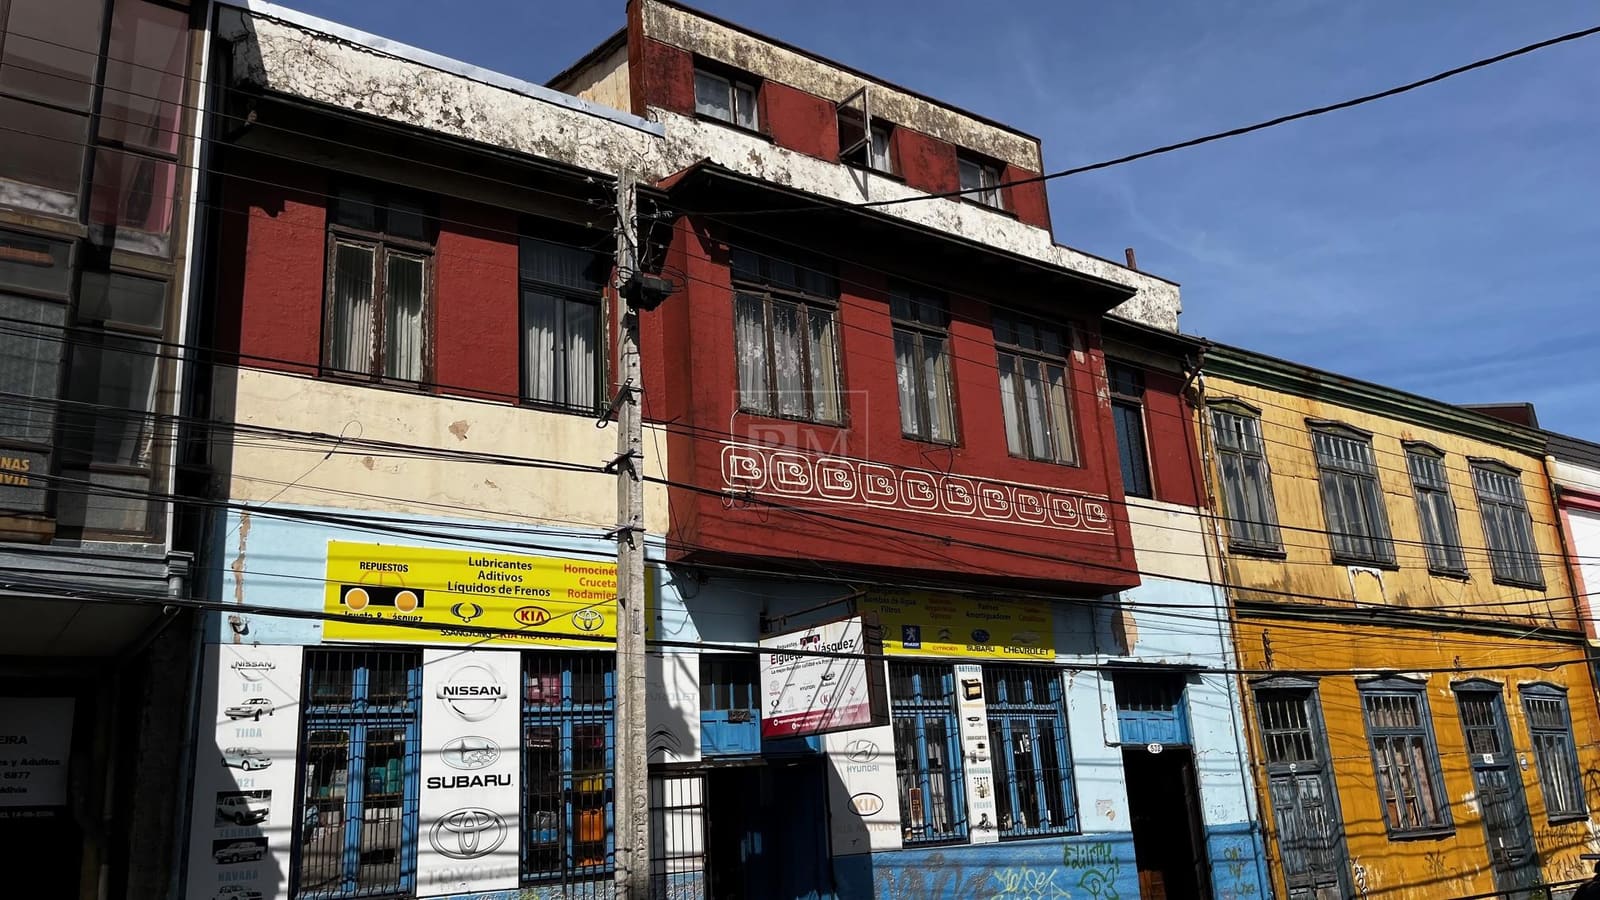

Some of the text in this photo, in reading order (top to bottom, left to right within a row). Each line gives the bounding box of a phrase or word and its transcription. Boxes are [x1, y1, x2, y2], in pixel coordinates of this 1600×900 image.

[360, 561, 409, 573] REPUESTOS
[469, 557, 532, 571] Lubricantes
[478, 570, 523, 583] Aditivos
[448, 581, 551, 597] Líquidos de Frenos
[521, 611, 545, 622] KIA
[966, 644, 995, 653] SUBARU
[235, 660, 273, 668] NISSAN
[443, 685, 502, 696] NISSAN
[236, 728, 263, 738] TIIDA
[21, 758, 60, 766] Adultos
[847, 765, 880, 773] HYUNDAI
[427, 774, 511, 790] SUBARU
[854, 798, 878, 811] KIA
[217, 871, 259, 882] NAVARA
